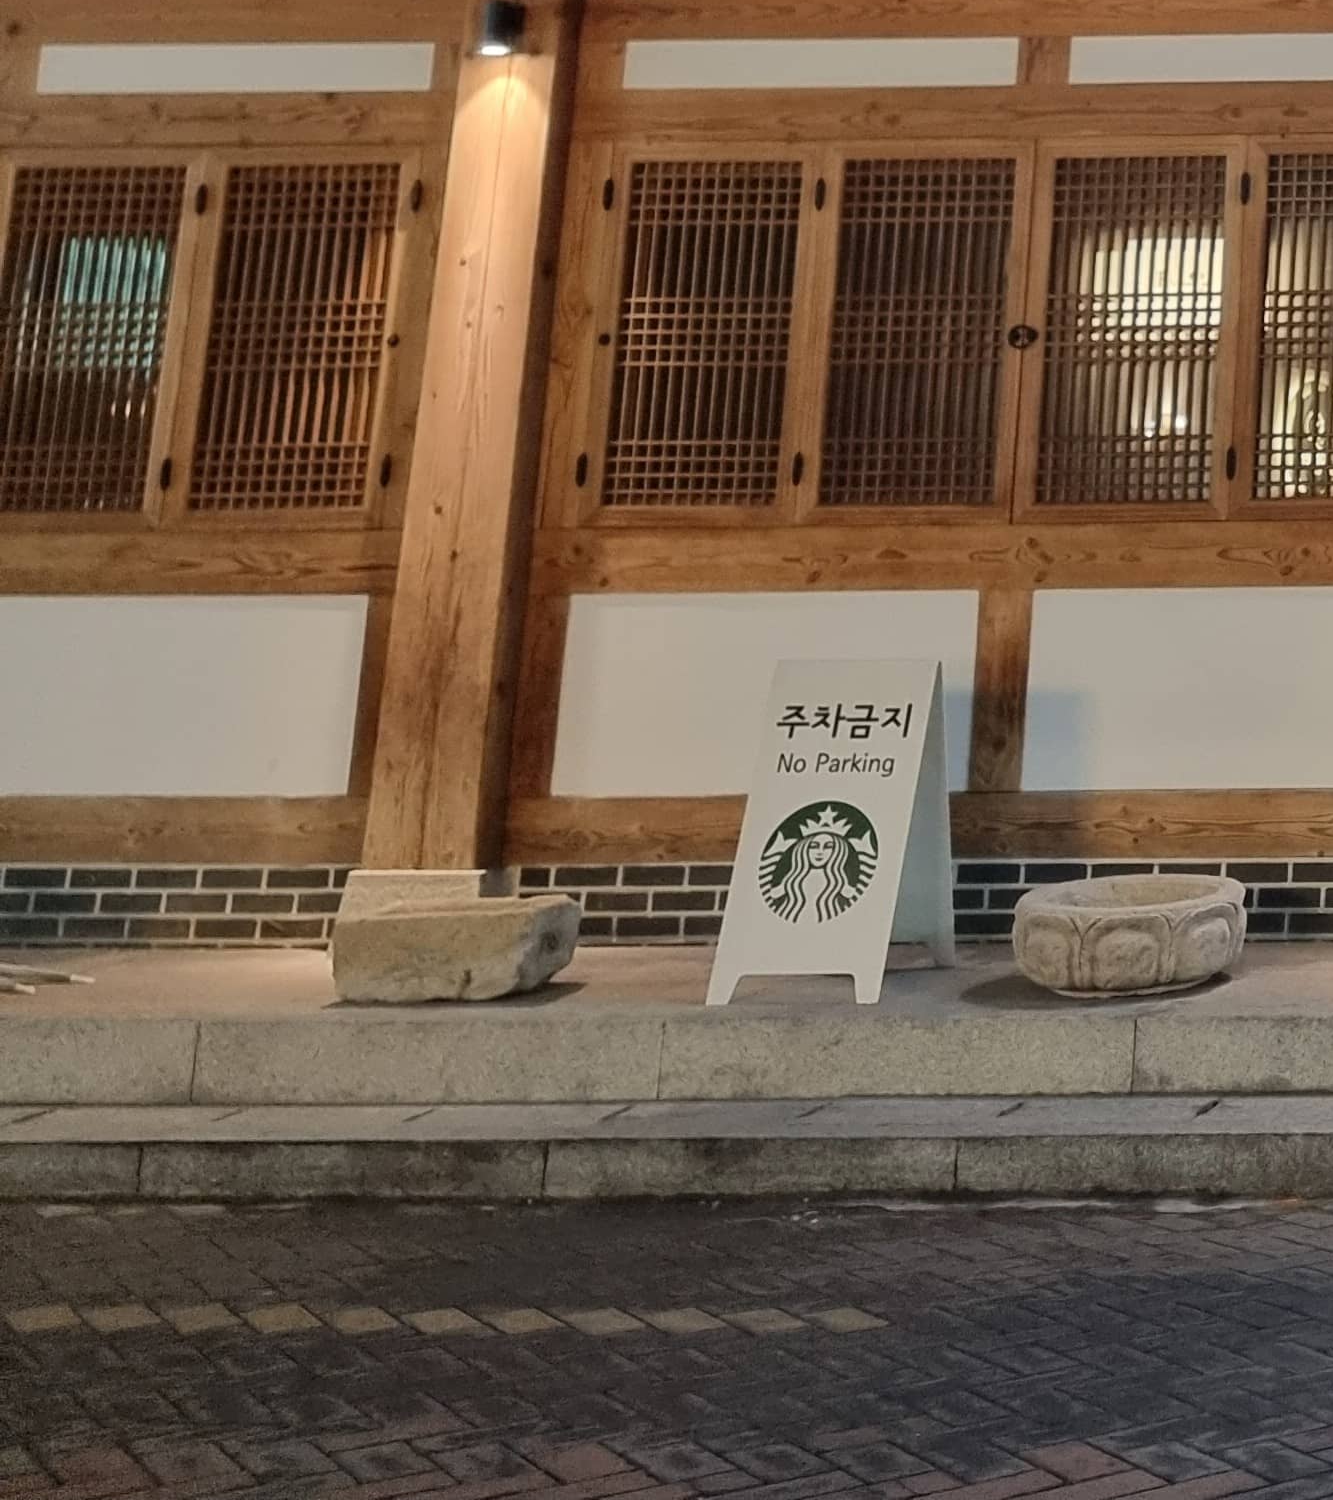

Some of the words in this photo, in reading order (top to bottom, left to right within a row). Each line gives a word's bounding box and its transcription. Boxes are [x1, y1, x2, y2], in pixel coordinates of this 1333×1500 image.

[776, 703, 913, 739] 주차금지
[776, 752, 807, 773] No
[815, 752, 895, 778] Parking
